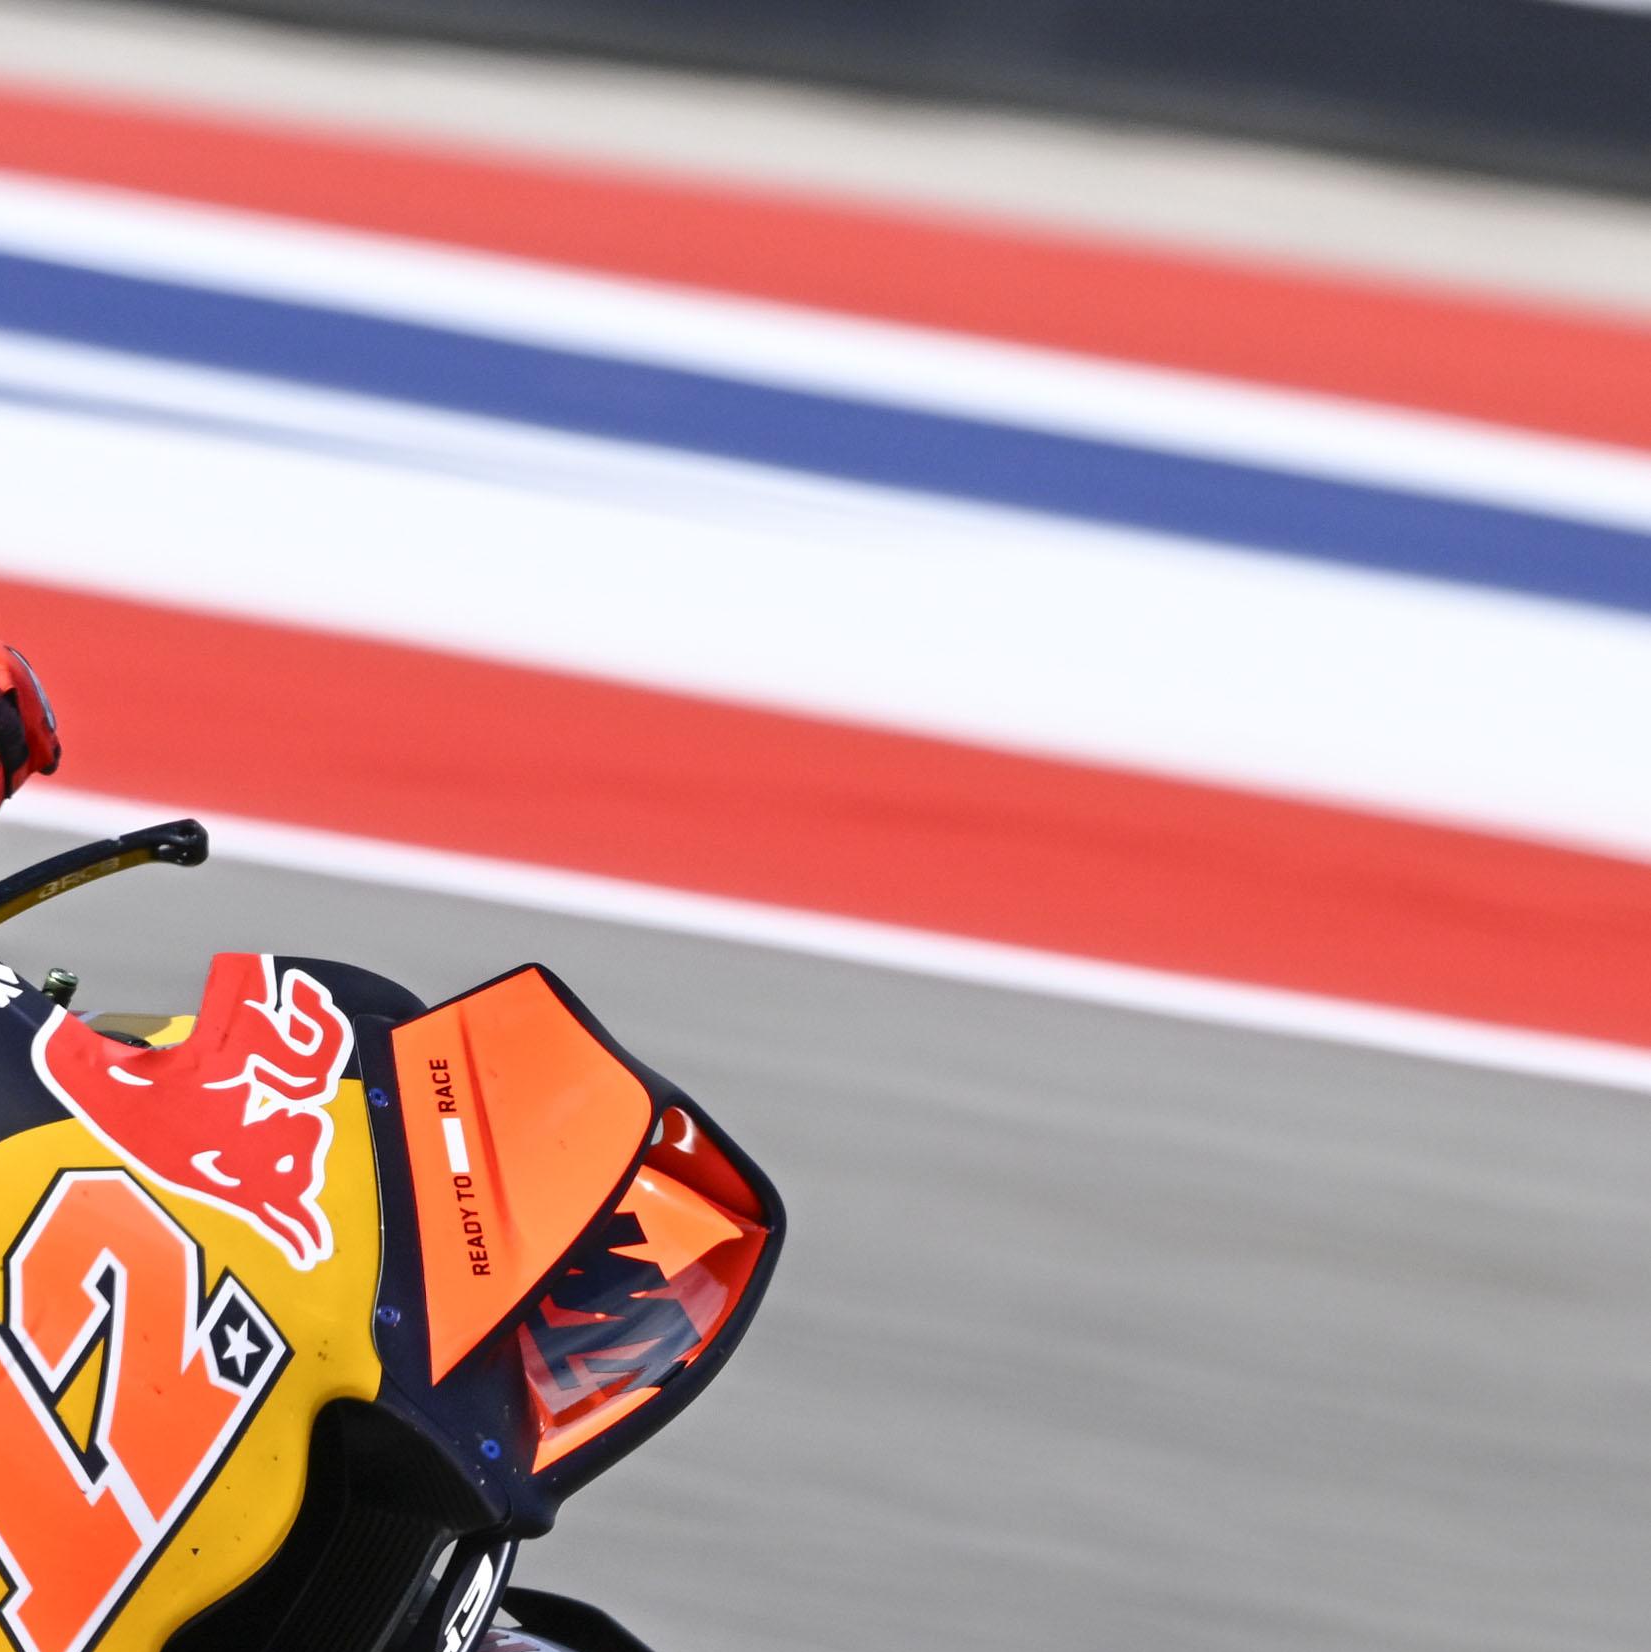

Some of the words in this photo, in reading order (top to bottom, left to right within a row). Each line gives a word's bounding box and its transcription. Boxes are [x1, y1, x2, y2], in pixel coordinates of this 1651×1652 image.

[429, 1059, 457, 1113] RACE
[453, 1175, 476, 1202] TO
[459, 1207, 491, 1276] READY
